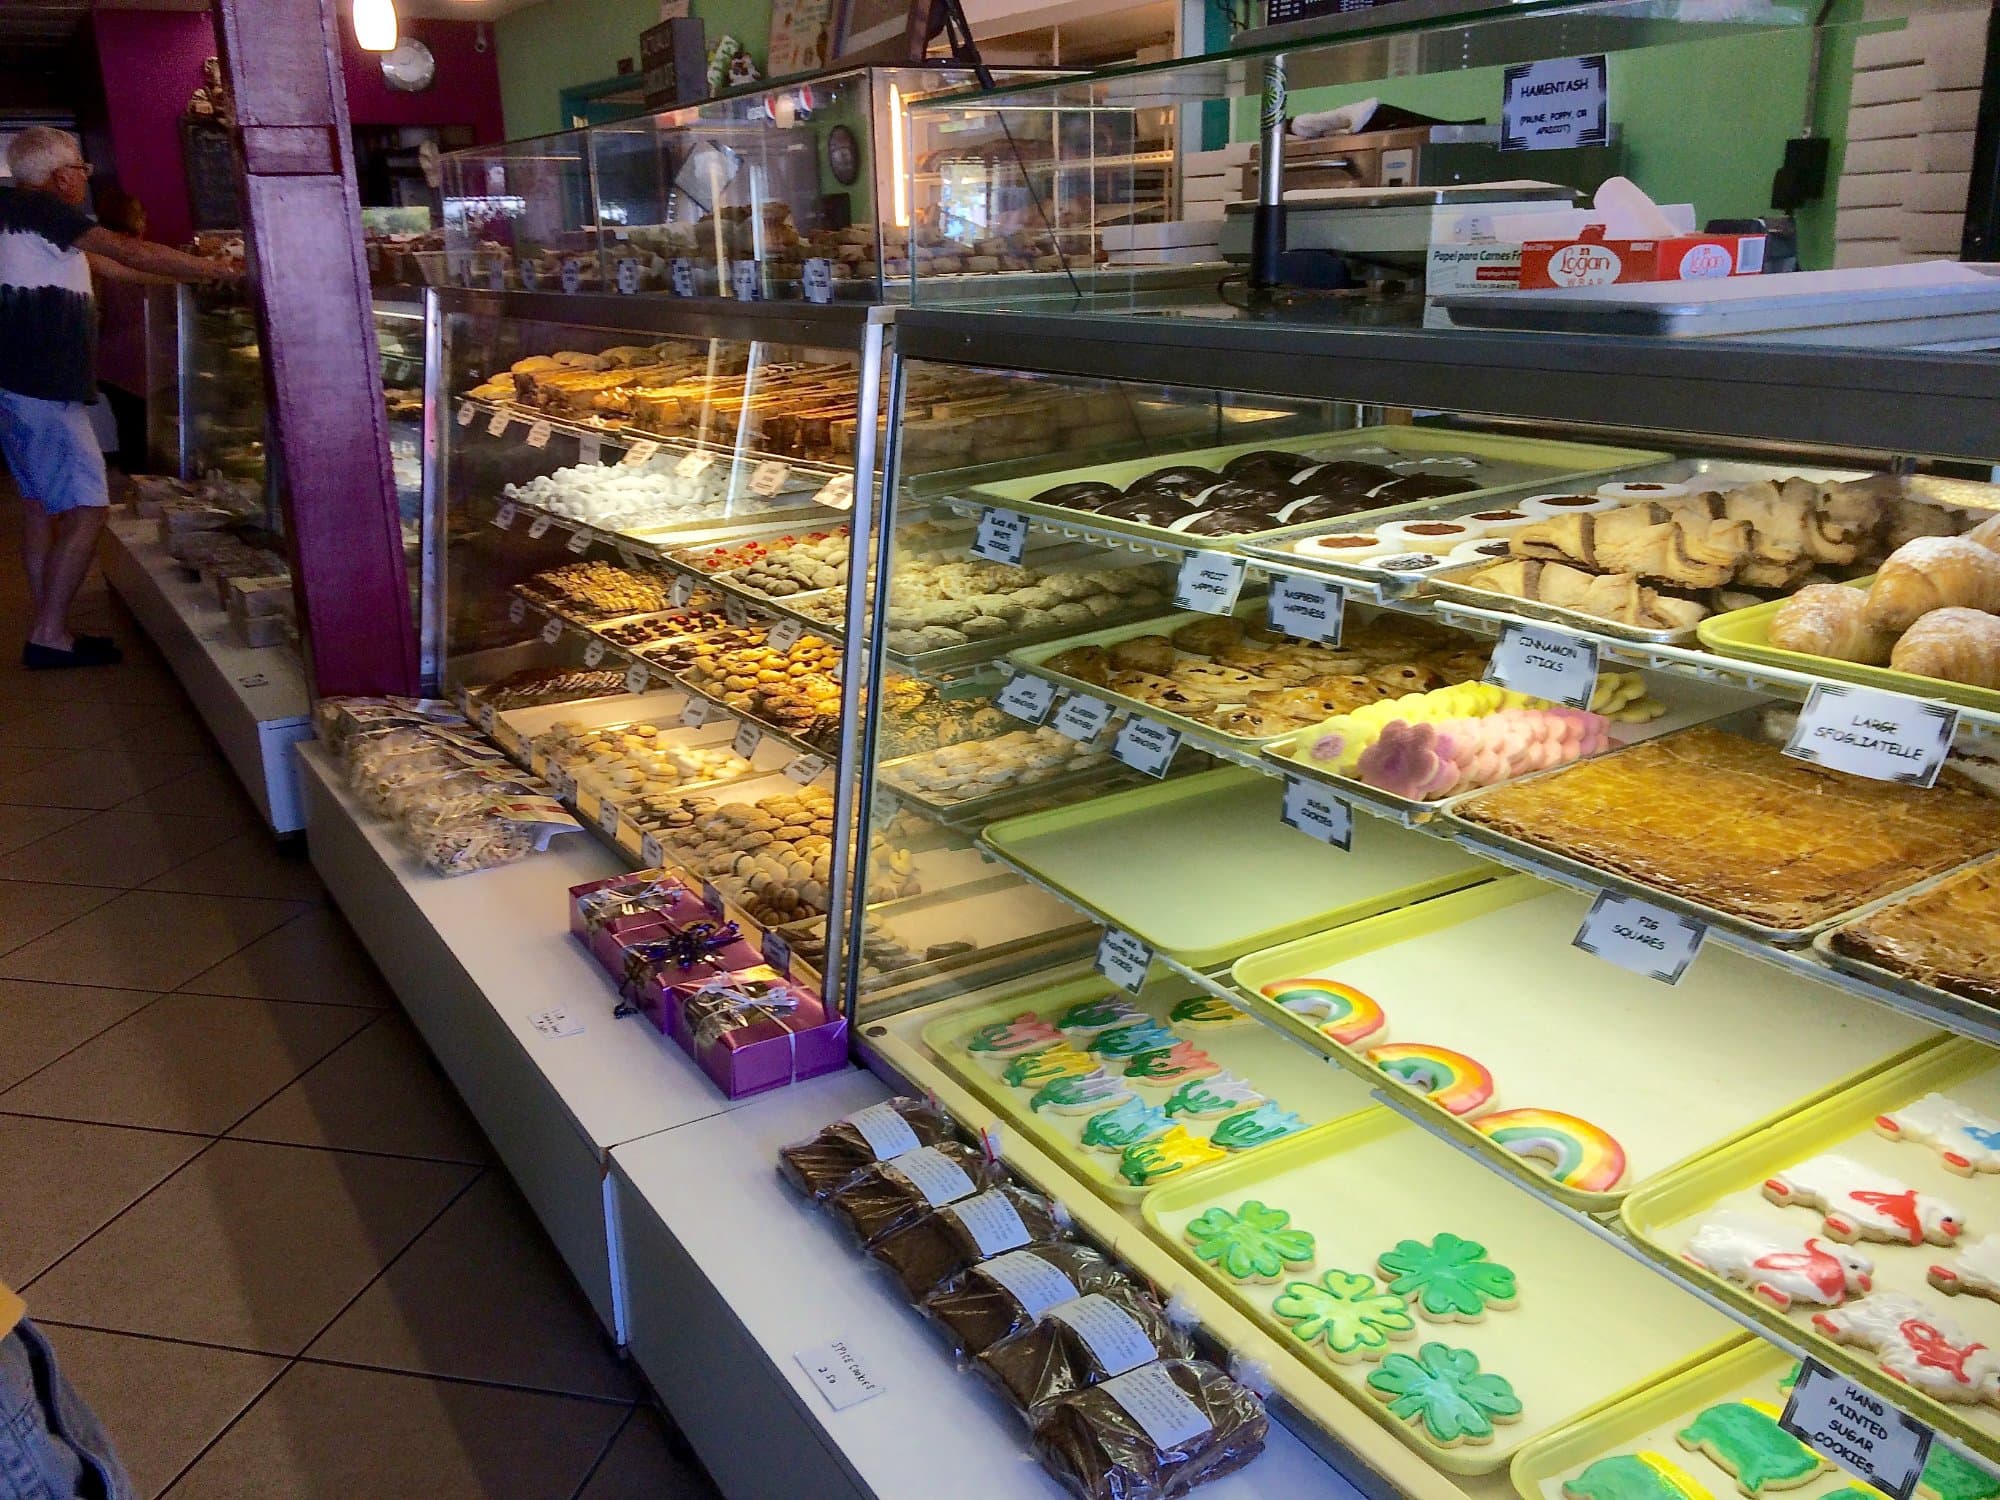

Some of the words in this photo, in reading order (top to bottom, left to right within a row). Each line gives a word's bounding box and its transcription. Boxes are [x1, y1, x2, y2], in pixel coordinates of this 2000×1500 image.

[1520, 78, 1589, 98] HAMENTASH
[1433, 250, 1458, 263] Papel
[1458, 252, 1478, 263] para
[1479, 249, 1510, 261] Carnes
[1560, 247, 1611, 278] Logan
[1688, 251, 1724, 276] Logan
[1520, 636, 1578, 659] CINNAMON
[1525, 654, 1564, 673] STICKS
[1851, 715, 1900, 735] LARGE
[1814, 726, 1924, 761] SFOGLIATELLE
[1637, 915, 1660, 930] FIG
[1611, 924, 1666, 951] SQUARES
[1845, 1386, 1884, 1417] HAND
[1828, 1396, 1888, 1440] PAINTED
[1828, 1419, 1874, 1453] SUGAR
[1814, 1431, 1875, 1475] COOKIES
